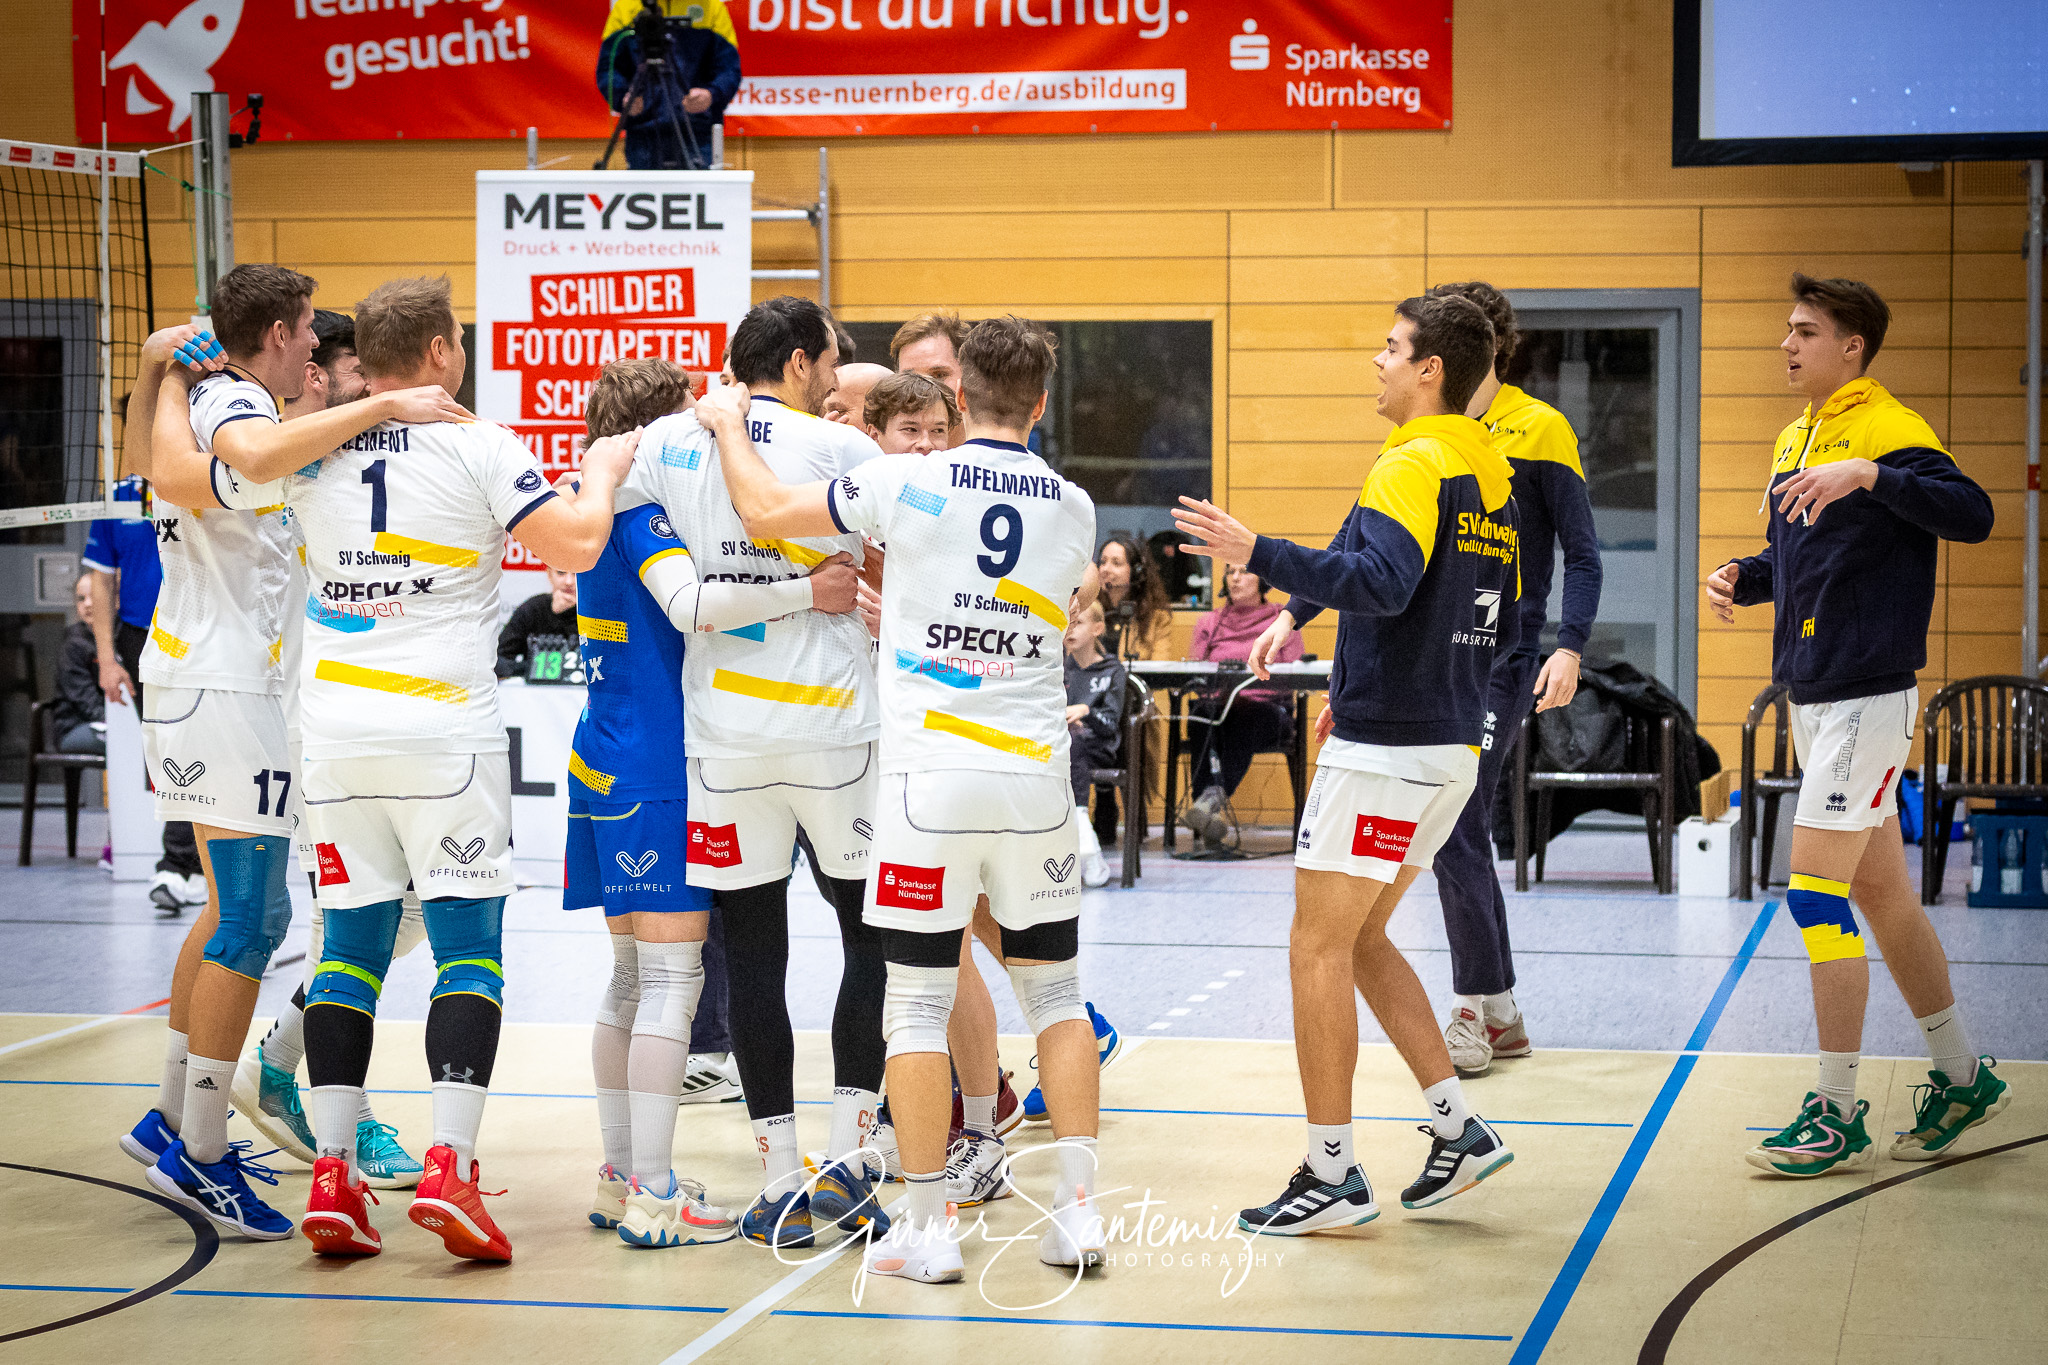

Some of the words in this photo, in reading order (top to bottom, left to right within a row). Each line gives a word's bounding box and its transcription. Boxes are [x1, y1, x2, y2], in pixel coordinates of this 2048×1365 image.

[748, 0, 862, 31] bist
[878, 0, 953, 29] du
[324, 15, 531, 90] gesucht!
[1285, 42, 1430, 76] Sparkasse
[1286, 79, 1421, 113] Nürnberg
[504, 193, 724, 230] MEYSEL
[504, 241, 560, 256] Druck
[585, 240, 721, 256] Werbetechnik
[539, 274, 683, 317] SCHILDER
[507, 328, 711, 367] FOTOTAPETEN
[361, 459, 388, 532] 1
[949, 463, 1061, 501] TAFELMAYER
[721, 541, 735, 556] SV
[976, 503, 1024, 578] 9
[338, 550, 352, 566] SV
[356, 550, 411, 567] Schwaig
[953, 592, 971, 609] SV
[974, 594, 1030, 619] Schwaig
[926, 624, 1019, 657] SPECK
[1801, 617, 1815, 639] FH
[534, 651, 563, 680] 13
[919, 655, 1014, 681] pumpen
[253, 768, 292, 818] 17
[1825, 804, 1847, 812] errea
[429, 868, 500, 879] OFFICEWELT
[604, 882, 672, 894] OFFICEWELT
[898, 878, 937, 891] Sparkasse
[898, 888, 934, 902] Nürnberg
